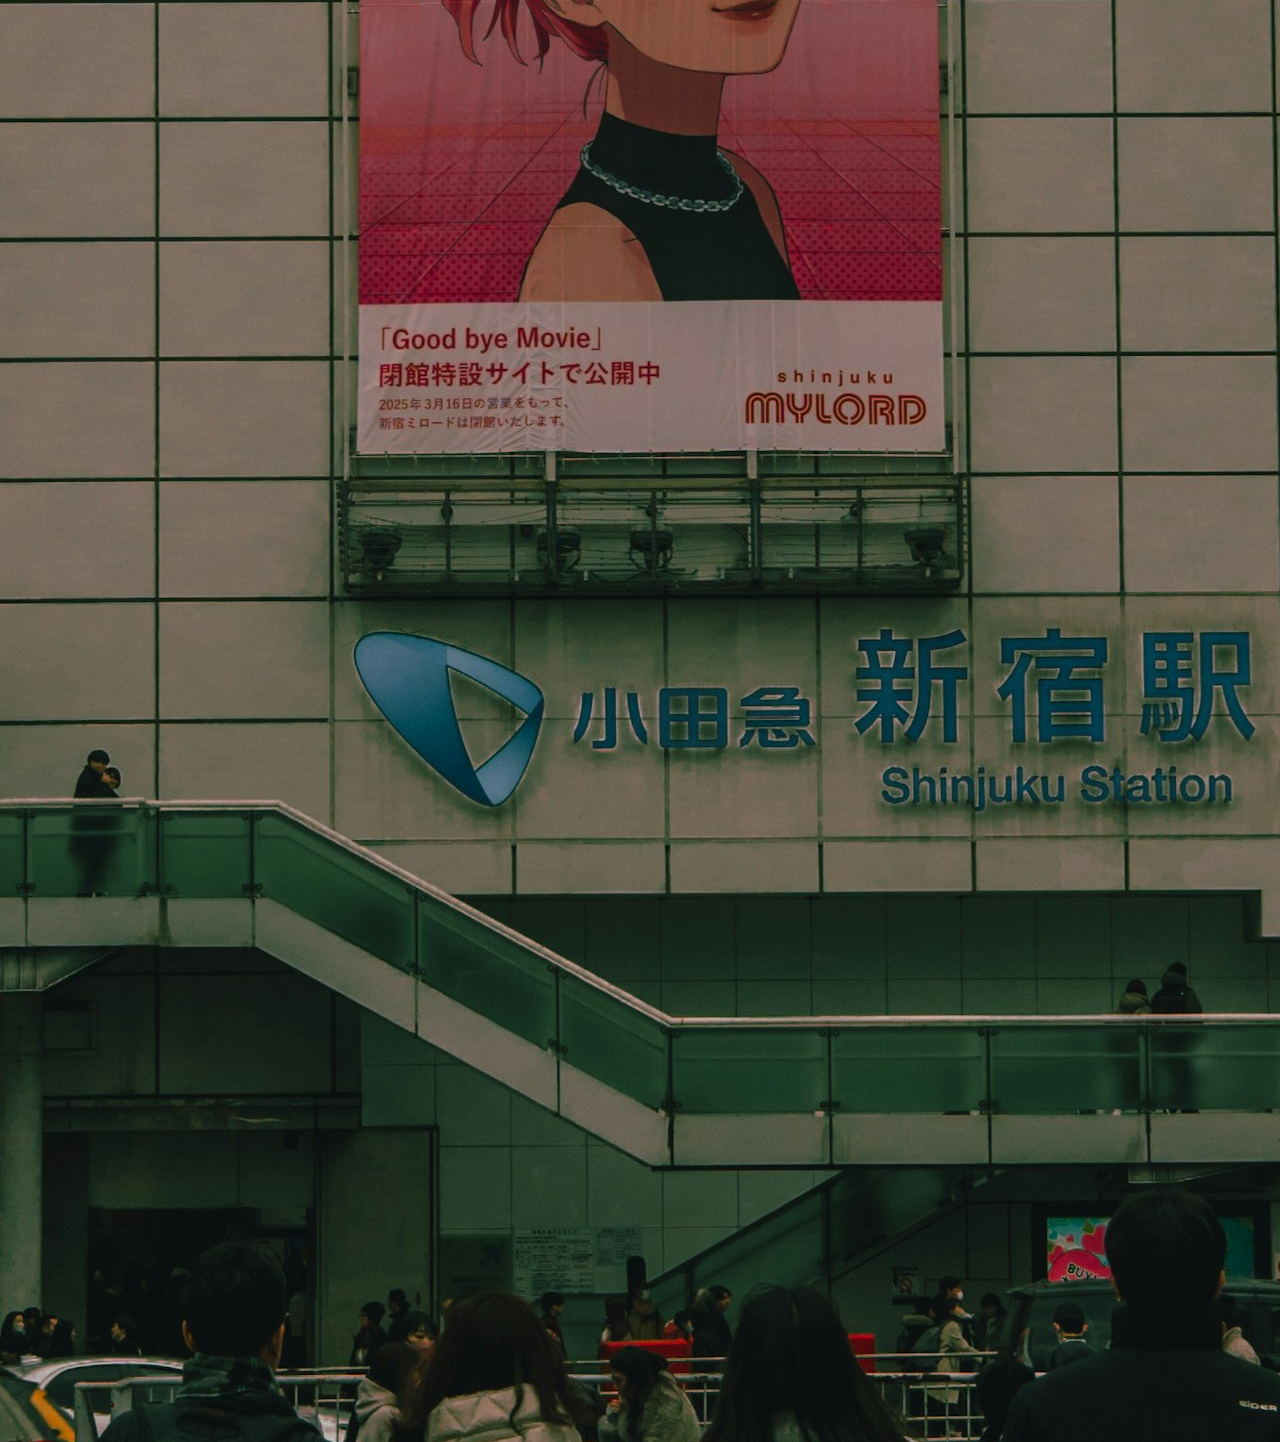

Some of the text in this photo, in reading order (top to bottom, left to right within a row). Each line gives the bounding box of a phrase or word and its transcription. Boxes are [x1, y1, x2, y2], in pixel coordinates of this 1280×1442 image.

[465, 326, 509, 353] bye
[378, 360, 662, 388] 閉館特設サイトで公開中
[777, 369, 895, 386] shinjuku
[745, 392, 927, 426] MYLORD
[573, 628, 1256, 750] 小田急 新宿駅
[880, 765, 1233, 812] Shinjuku Station
